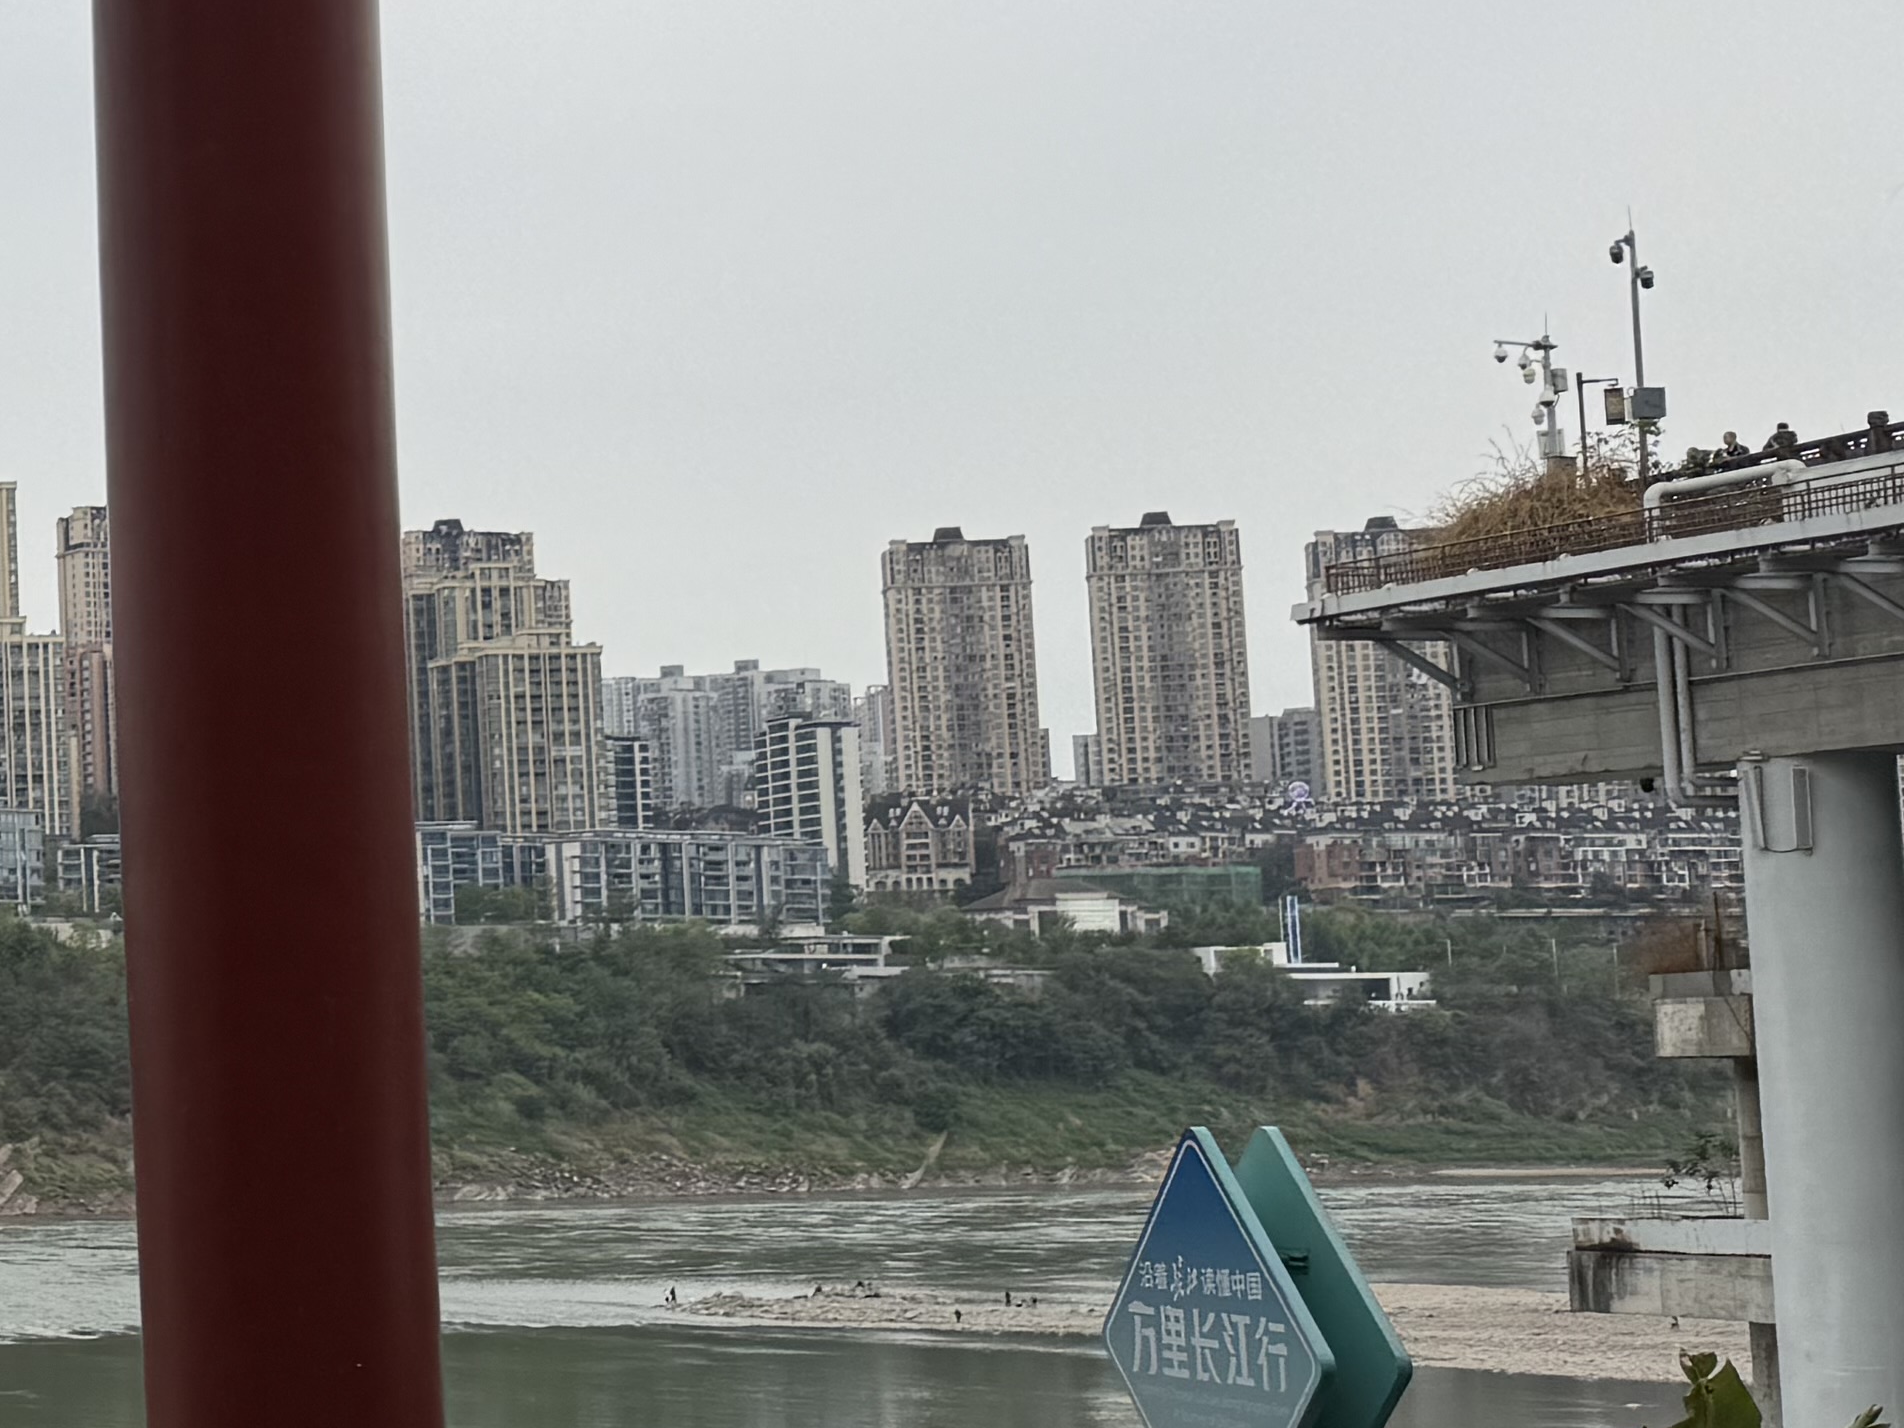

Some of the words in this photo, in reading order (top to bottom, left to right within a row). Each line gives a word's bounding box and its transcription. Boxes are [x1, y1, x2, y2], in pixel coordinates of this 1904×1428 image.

[1127, 1300, 1288, 1393] 万里长江行
